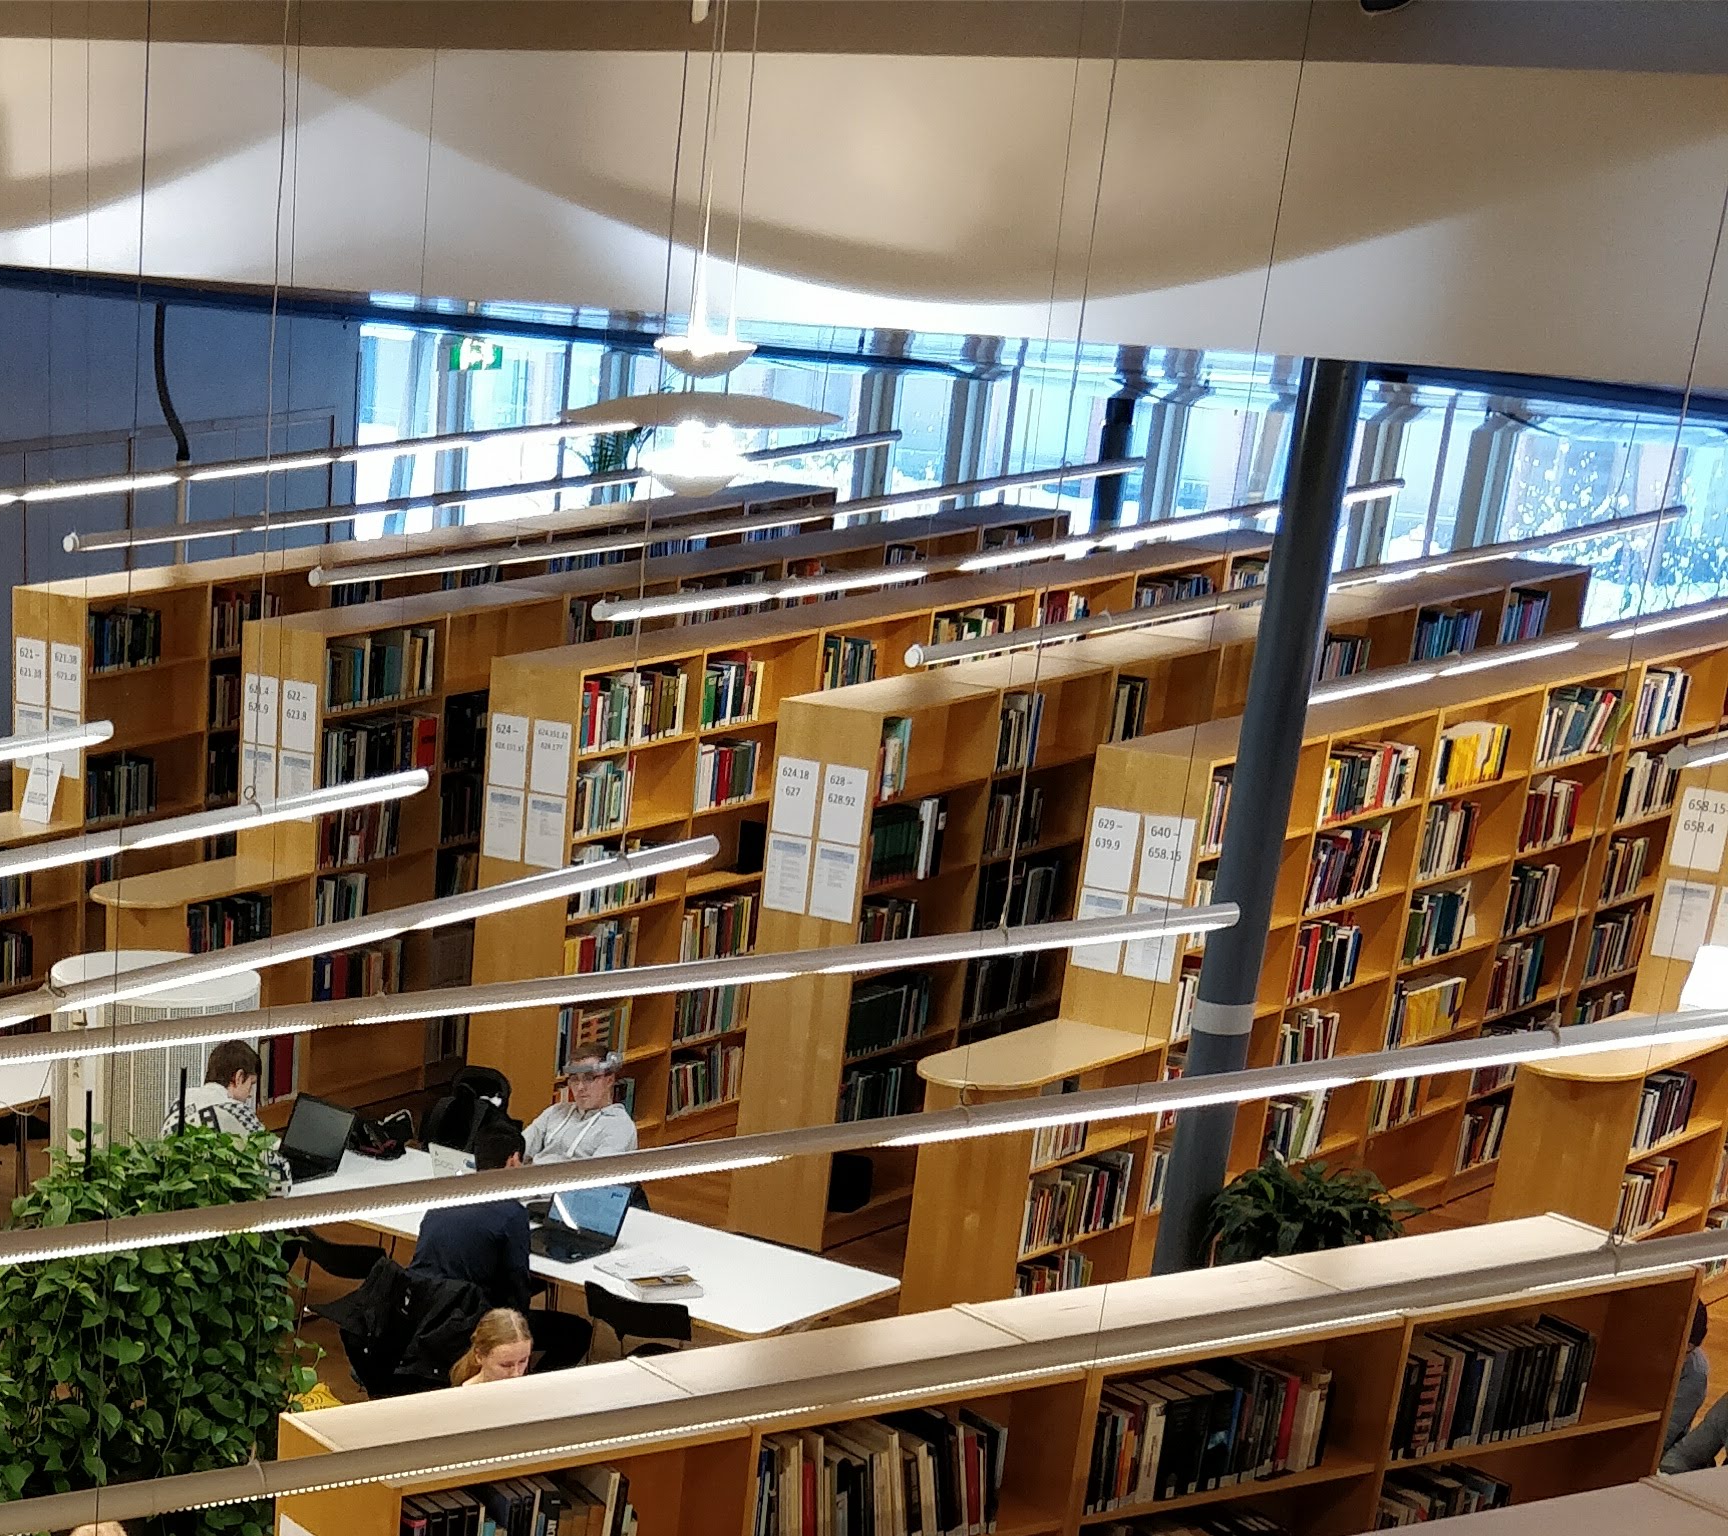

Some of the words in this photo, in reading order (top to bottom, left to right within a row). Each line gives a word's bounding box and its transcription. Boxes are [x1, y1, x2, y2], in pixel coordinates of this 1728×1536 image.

[782, 766, 810, 780] 624.18
[1097, 817, 1116, 831] 629
[1683, 819, 1715, 835] 658.4
[1150, 825, 1172, 839] 640
[1094, 836, 1121, 851] 639.9
